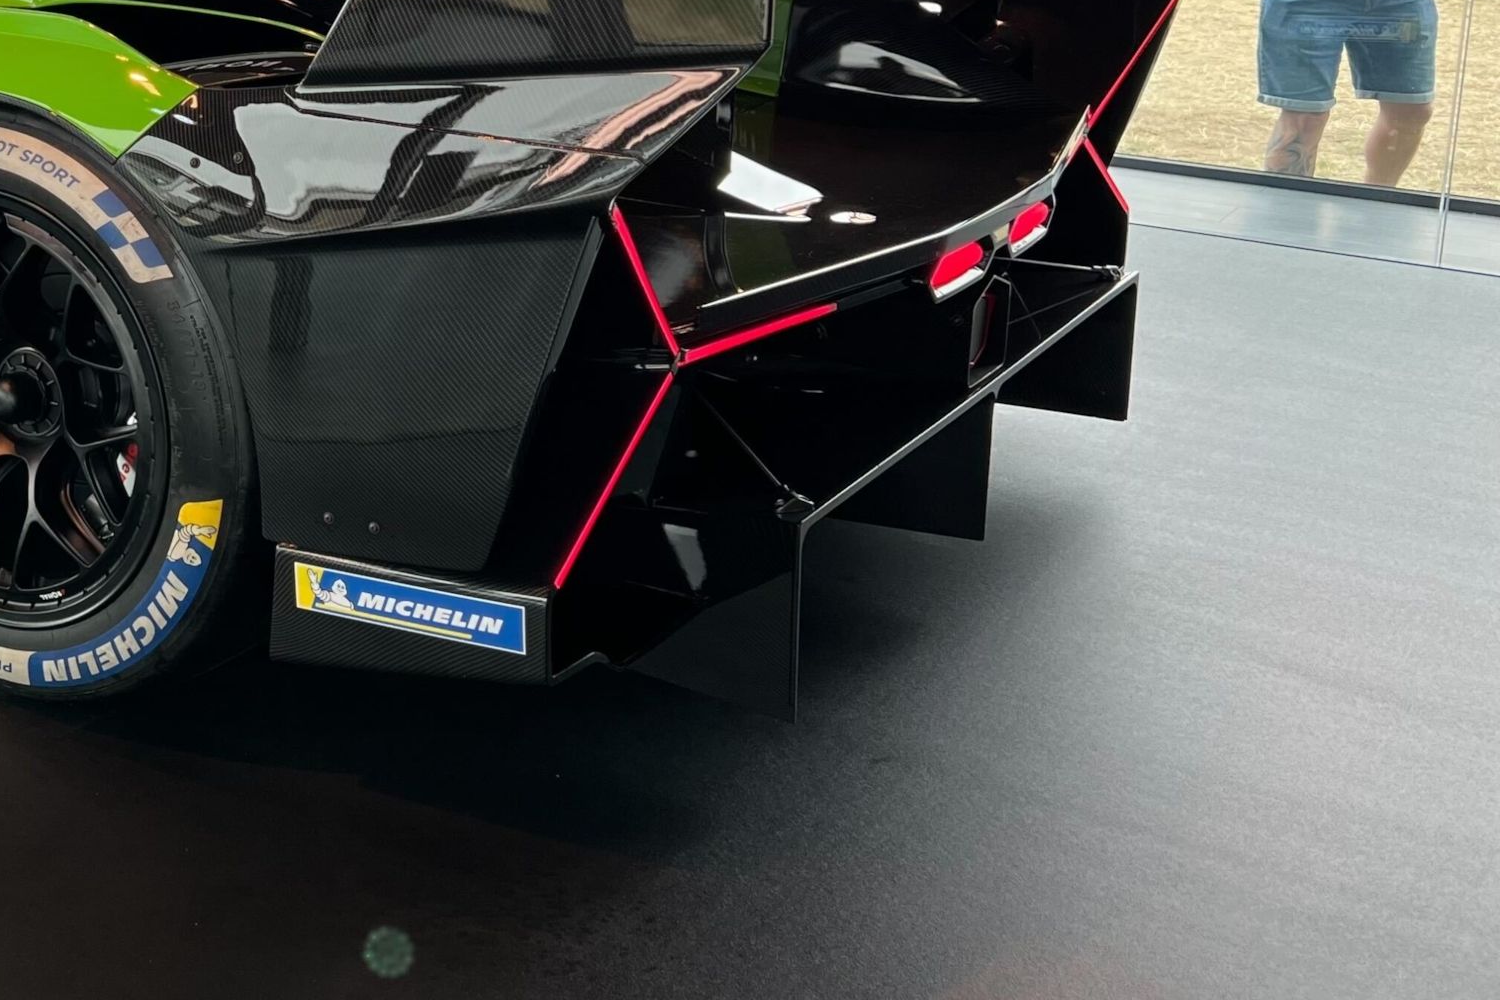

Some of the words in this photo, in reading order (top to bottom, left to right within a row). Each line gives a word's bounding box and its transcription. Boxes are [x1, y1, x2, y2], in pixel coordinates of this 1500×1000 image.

[19, 149, 81, 189] SPORT
[42, 570, 189, 682] MICHELIN
[357, 591, 504, 636] MICHELIN
